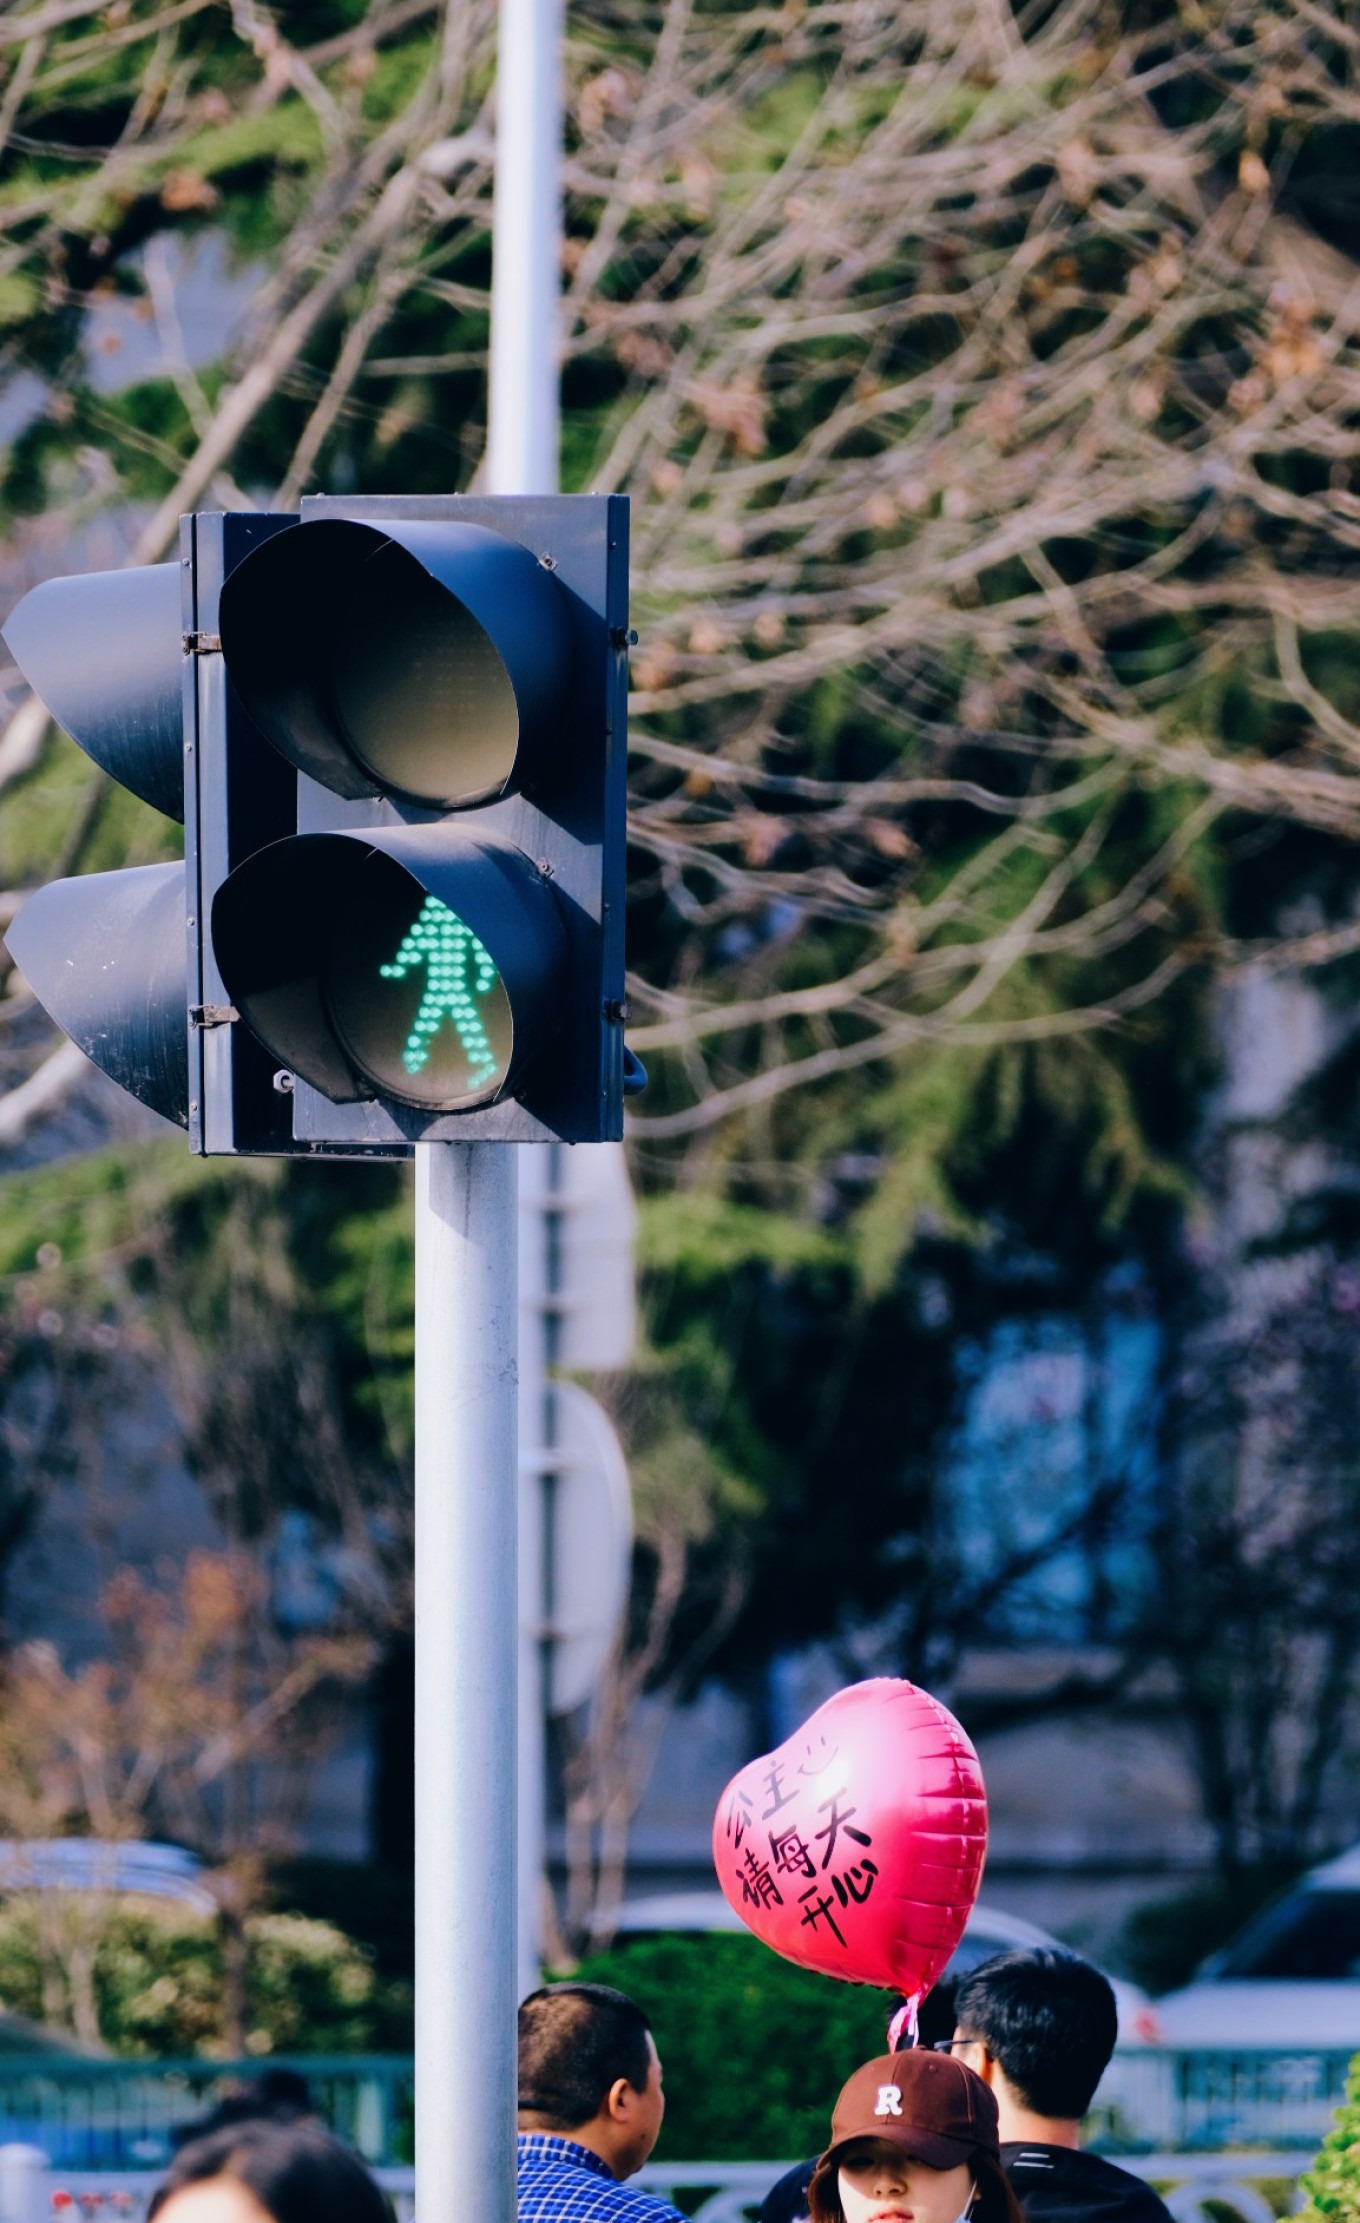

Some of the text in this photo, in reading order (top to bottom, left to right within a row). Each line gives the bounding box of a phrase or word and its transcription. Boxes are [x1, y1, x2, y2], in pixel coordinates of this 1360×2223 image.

[726, 1760, 800, 1849] 公主
[735, 1786, 872, 1910] 请每天
[797, 1858, 879, 1948] 开心
[874, 2084, 903, 2116] R
